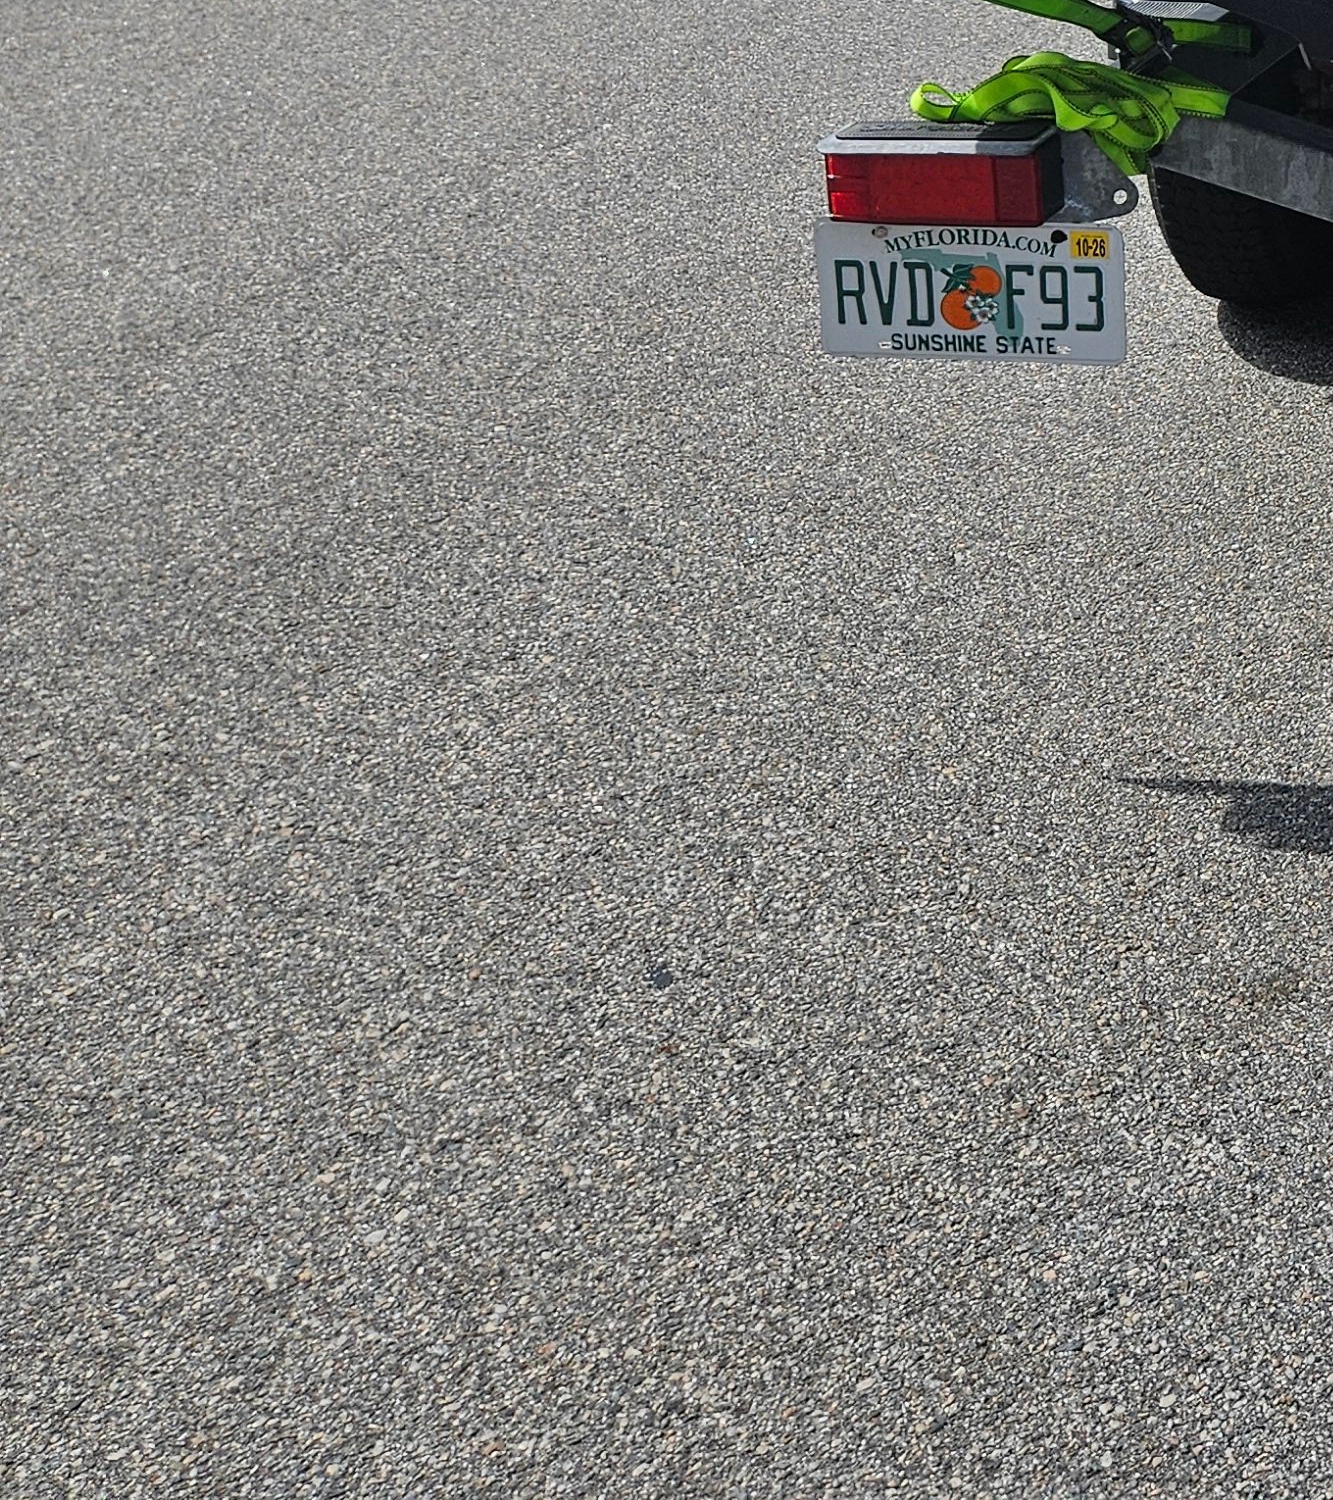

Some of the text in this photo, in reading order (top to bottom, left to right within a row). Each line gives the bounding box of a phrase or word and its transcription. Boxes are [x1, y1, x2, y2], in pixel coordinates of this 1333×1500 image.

[884, 228, 1057, 258] MYFLORIDA.COM
[1076, 238, 1106, 257] 10-26
[834, 259, 1104, 332] RVD F93
[891, 333, 1057, 355] SUNSHINE STATE
